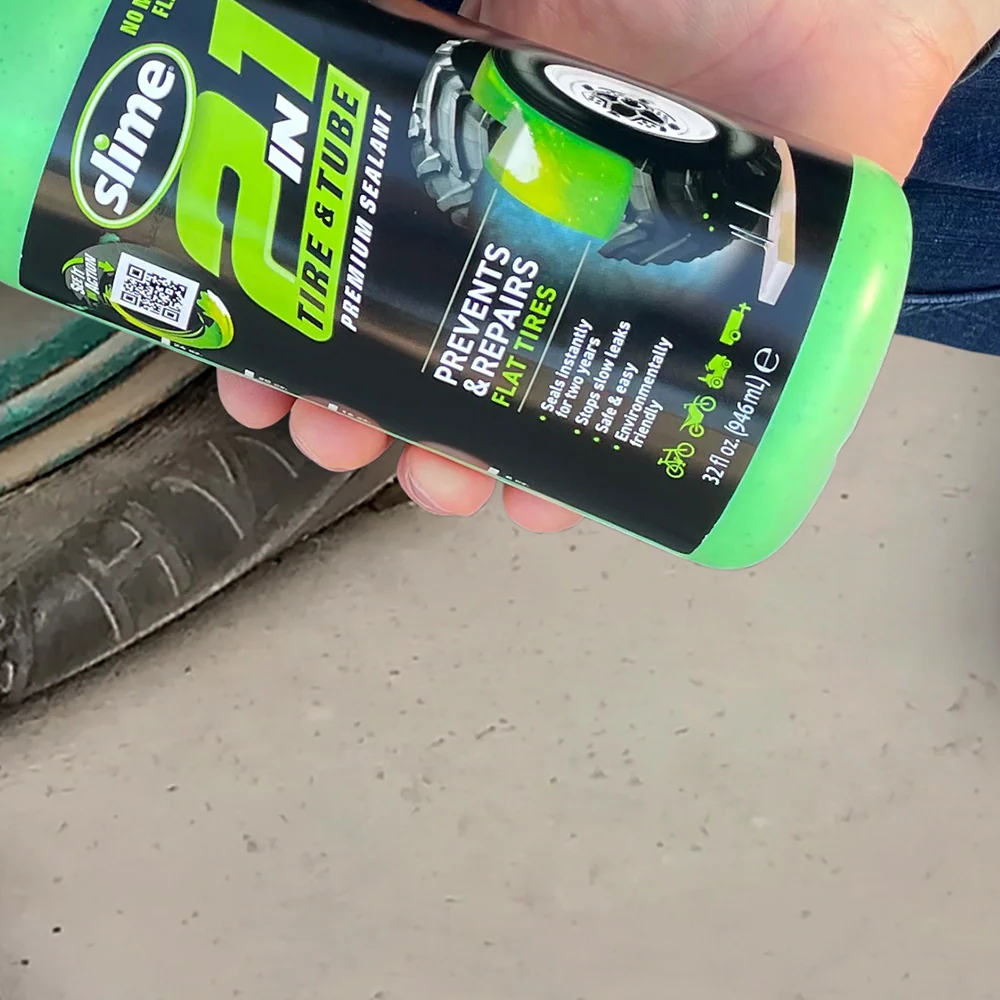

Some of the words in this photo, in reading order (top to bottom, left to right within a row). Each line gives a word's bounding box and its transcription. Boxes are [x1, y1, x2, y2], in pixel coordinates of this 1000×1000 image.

[119, 9, 145, 37] NO
[89, 59, 176, 216] slime
[267, 93, 310, 185] IN
[317, 82, 360, 201] TUBE
[314, 200, 336, 229] &
[340, 214, 374, 333] PREMIUM
[359, 103, 393, 216] SEALANT
[297, 232, 334, 332] TIRE
[432, 242, 511, 387] PREVENTS
[470, 256, 540, 378] REPAIRS
[462, 378, 491, 398] &
[490, 354, 528, 408] FLAT
[513, 284, 557, 352] TIRES
[540, 384, 566, 413] Seals
[555, 318, 594, 379] instantly
[555, 399, 573, 419] for
[564, 375, 584, 400] two
[577, 336, 601, 377] years
[574, 391, 601, 427] Stops
[593, 358, 615, 392] slow
[604, 320, 632, 359] leaks
[614, 336, 674, 443] Environmentally
[594, 407, 618, 435] Safe
[607, 395, 623, 407] &
[616, 361, 639, 395] easy
[629, 399, 664, 448] friendly
[720, 438, 741, 456] oz.
